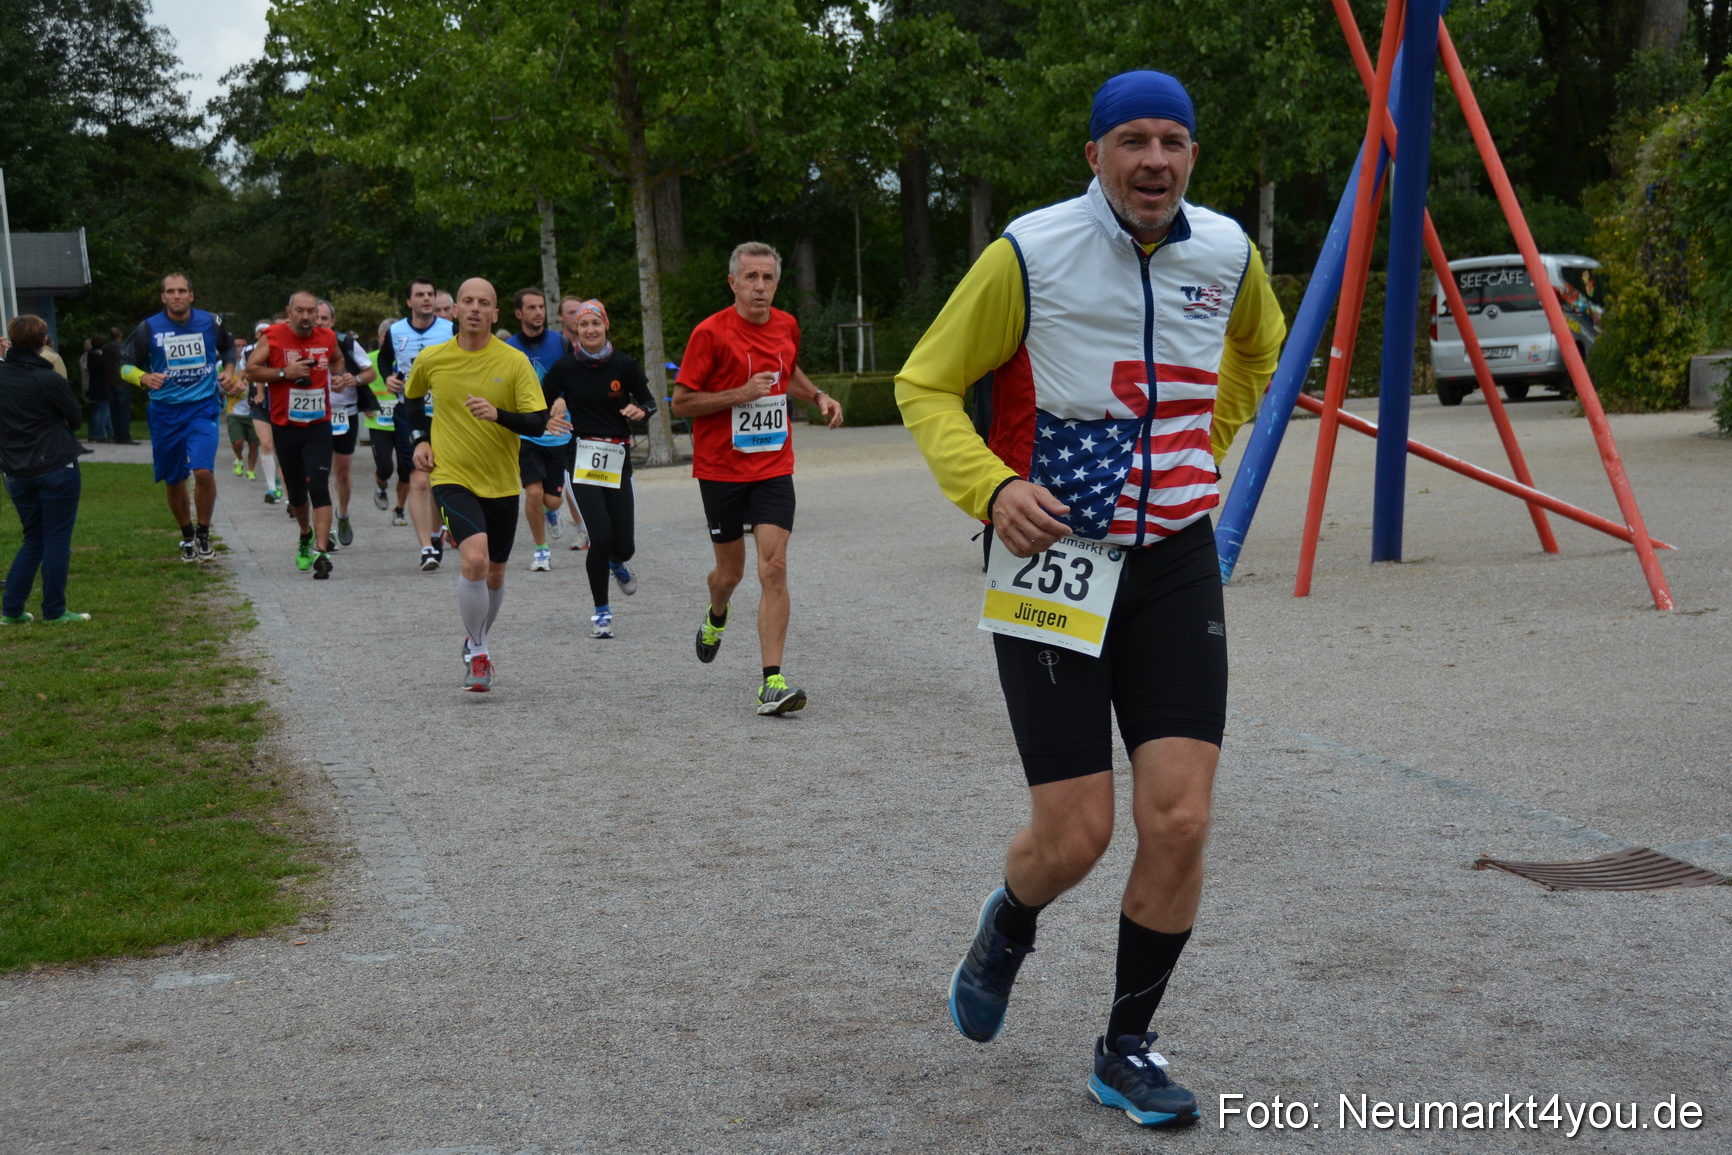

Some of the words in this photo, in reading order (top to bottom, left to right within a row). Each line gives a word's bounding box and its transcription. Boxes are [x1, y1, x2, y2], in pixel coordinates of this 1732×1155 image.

[169, 342, 202, 358] 2019
[397, 336, 408, 351] 7
[293, 397, 323, 411] 2211
[755, 401, 779, 409] Neumarkt
[739, 408, 783, 432] 2440
[752, 436, 772, 445] Franz
[591, 452, 609, 470] 61
[586, 471, 609, 481] Annette
[1012, 549, 1094, 601] 253
[1014, 601, 1068, 629] Jürgen
